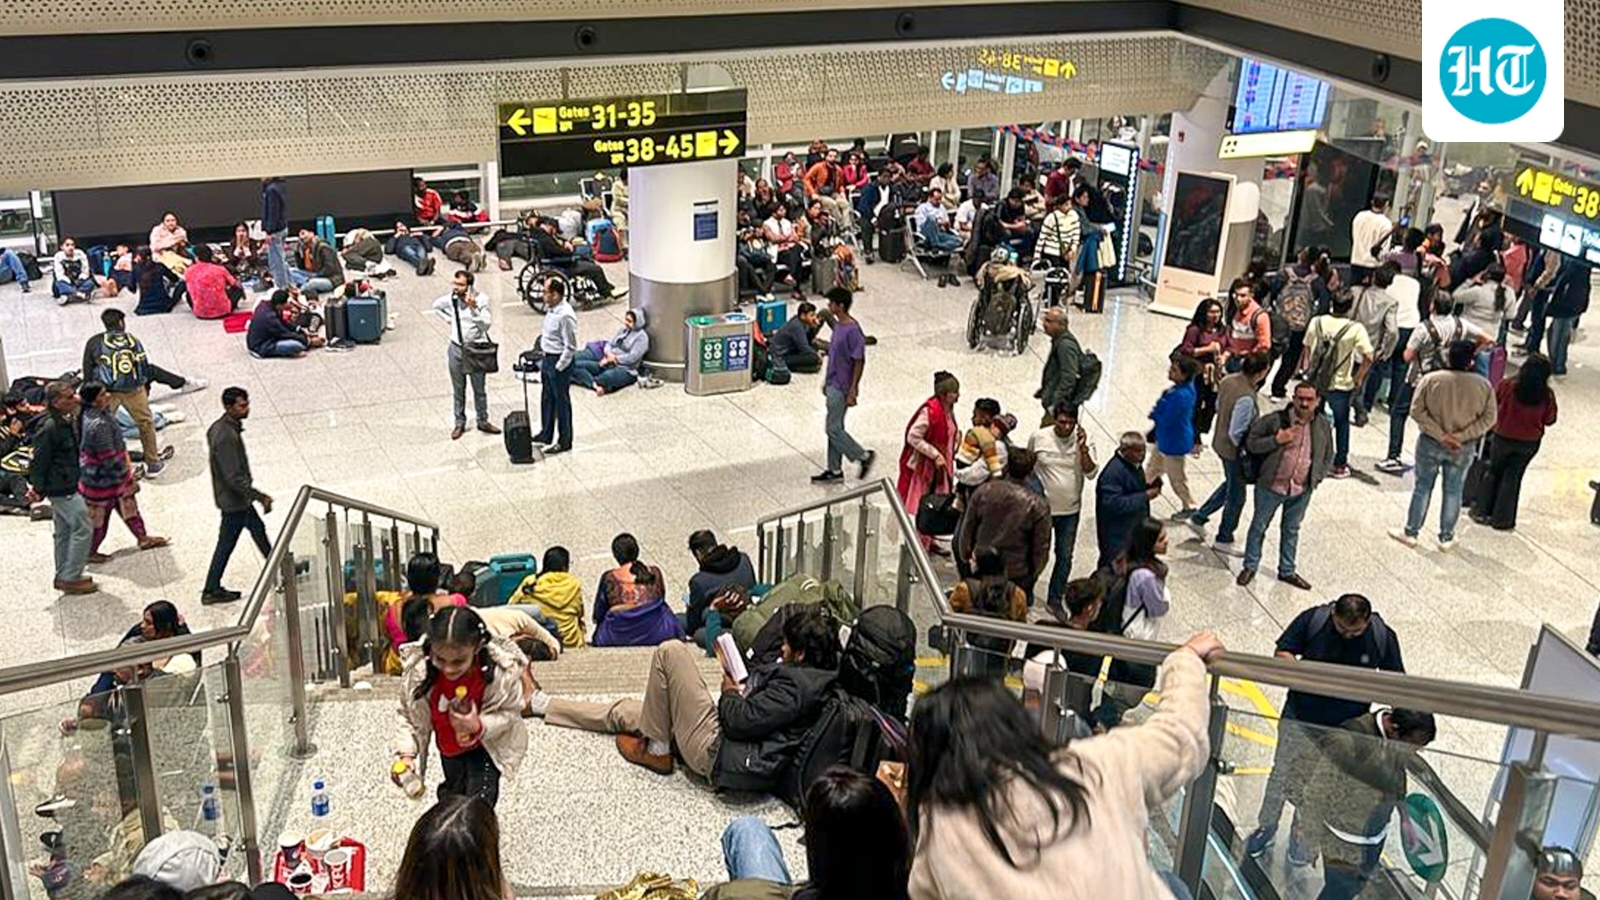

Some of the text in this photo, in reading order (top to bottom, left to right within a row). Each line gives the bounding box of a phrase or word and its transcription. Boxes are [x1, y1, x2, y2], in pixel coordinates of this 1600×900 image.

[559, 106, 590, 119] Gates
[591, 101, 656, 129] 31-35
[594, 139, 625, 153] Gates
[625, 133, 694, 163] 38-45
[331, 864, 346, 889] KFC
